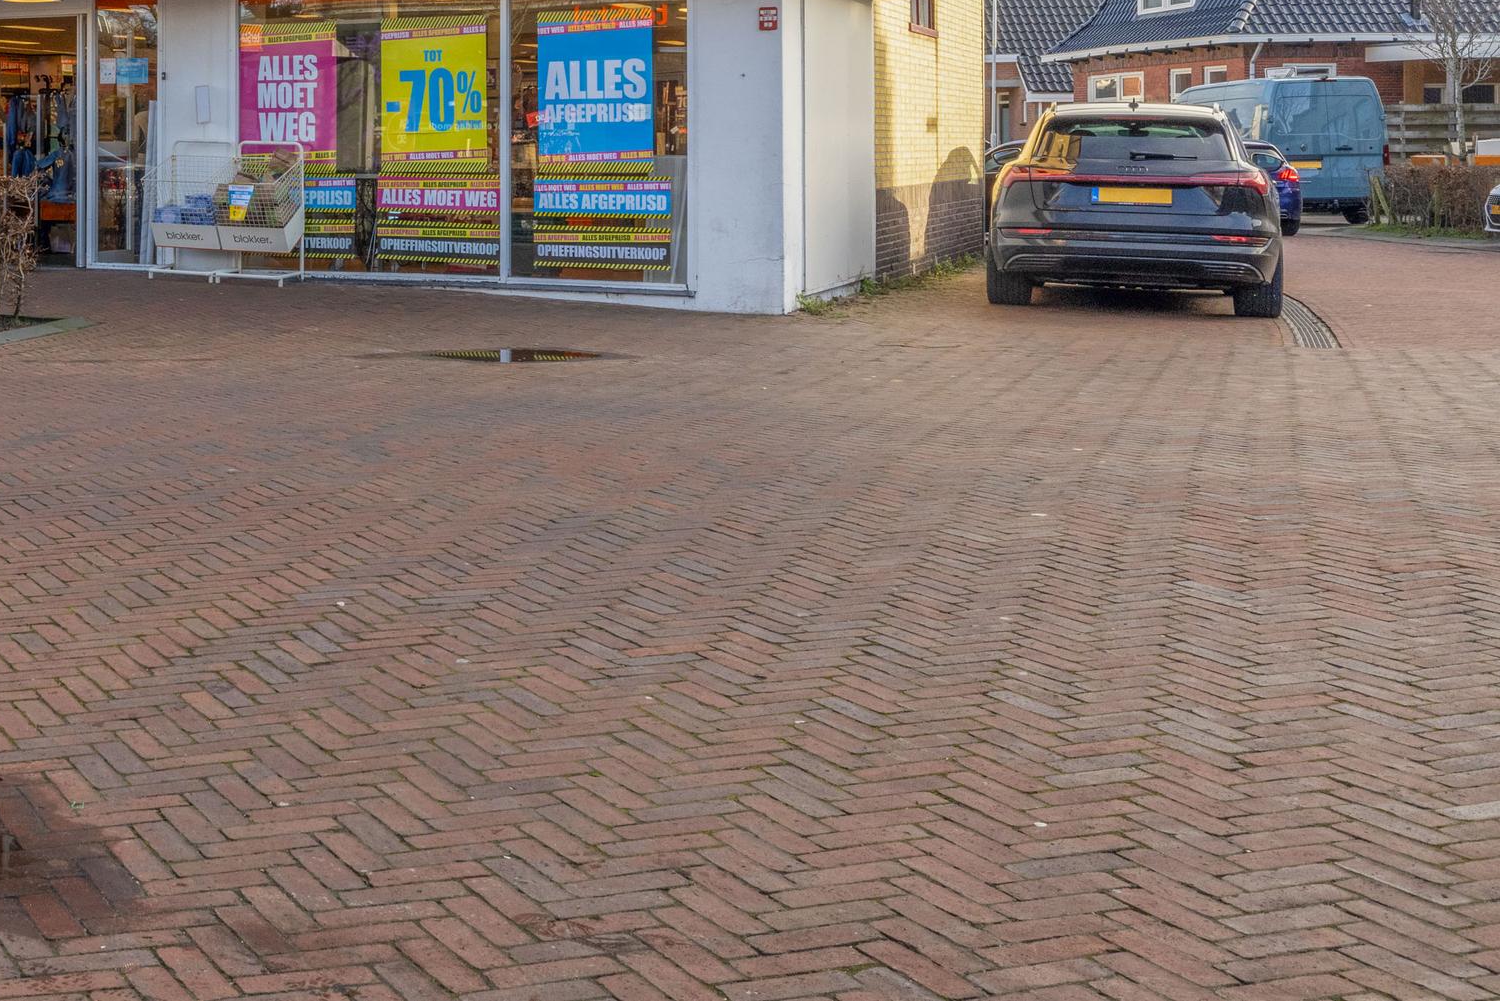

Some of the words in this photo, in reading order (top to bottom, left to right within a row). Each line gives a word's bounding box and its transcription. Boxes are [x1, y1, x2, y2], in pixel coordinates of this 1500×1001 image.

[619, 20, 636, 29] ALLES
[423, 49, 443, 62] TOT
[257, 54, 319, 81] ALLES
[544, 57, 647, 100] ALLES
[257, 82, 318, 109] MOET
[386, 67, 483, 132] -70%
[545, 102, 647, 123] AFGEPRIJSD
[258, 111, 317, 143] WEG
[604, 152, 618, 160] WEG
[305, 190, 352, 206] EPRIJSD
[381, 188, 421, 205] ALLES
[424, 190, 462, 206] MOET
[464, 191, 497, 208] WEG
[538, 191, 579, 209] ALLES
[581, 193, 667, 211] AFGEPRIJSD
[165, 231, 204, 241] blokker.
[232, 234, 273, 245] blokker.
[380, 238, 500, 256] OPHEFFINGSUITVERKOOP
[537, 244, 667, 260] OPHEFFINGSUITVERKOOP
